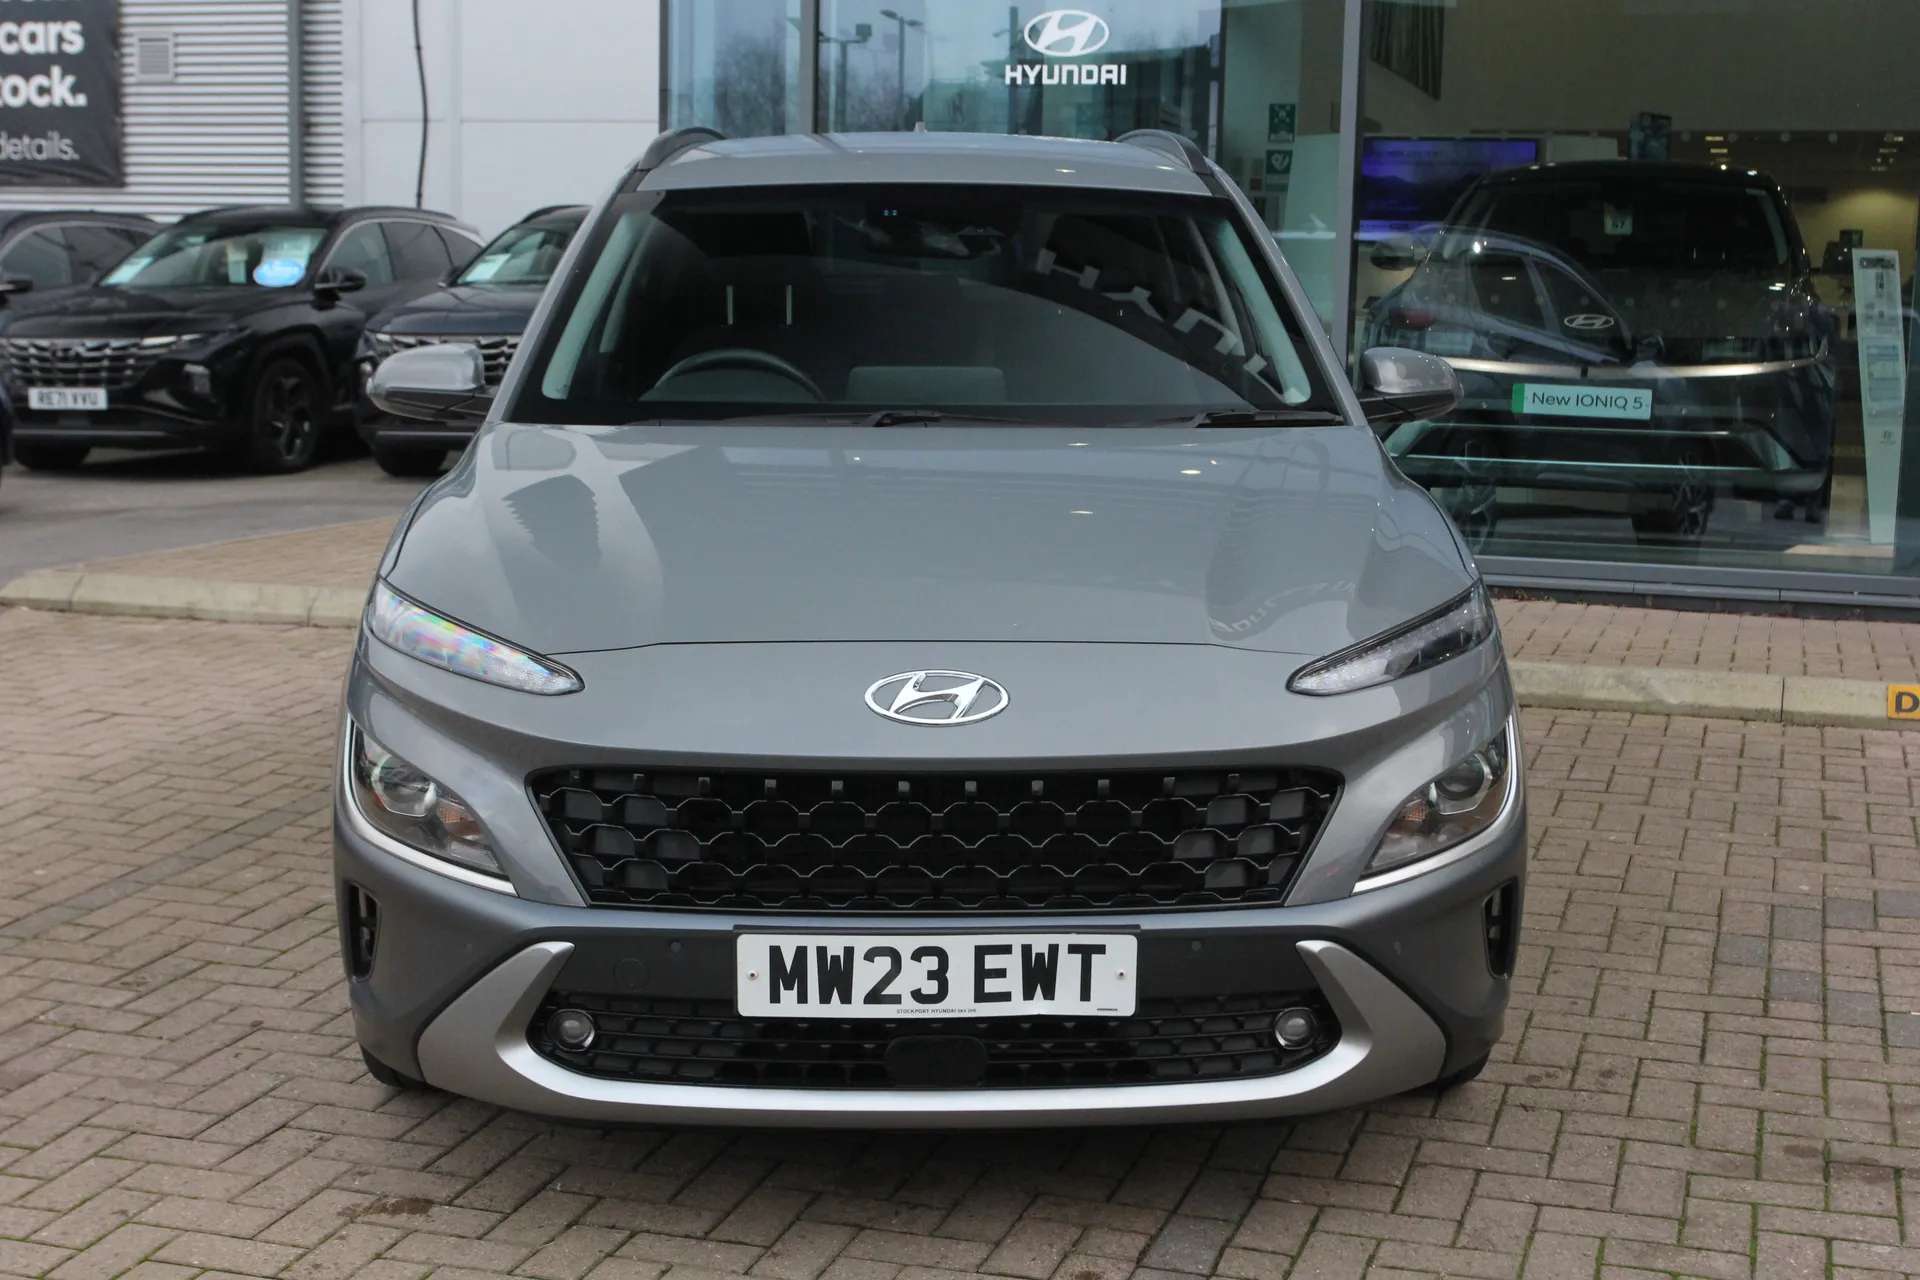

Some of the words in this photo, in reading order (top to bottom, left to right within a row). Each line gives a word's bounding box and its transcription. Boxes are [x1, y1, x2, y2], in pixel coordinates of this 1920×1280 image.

[0, 20, 85, 54] cars
[1004, 63, 1127, 85] HYUNDAI
[1532, 391, 1570, 406] New
[1575, 393, 1629, 411] IONIQ
[1632, 396, 1644, 410] 5
[768, 944, 950, 1005] MW23
[973, 943, 1107, 1004] EWT
